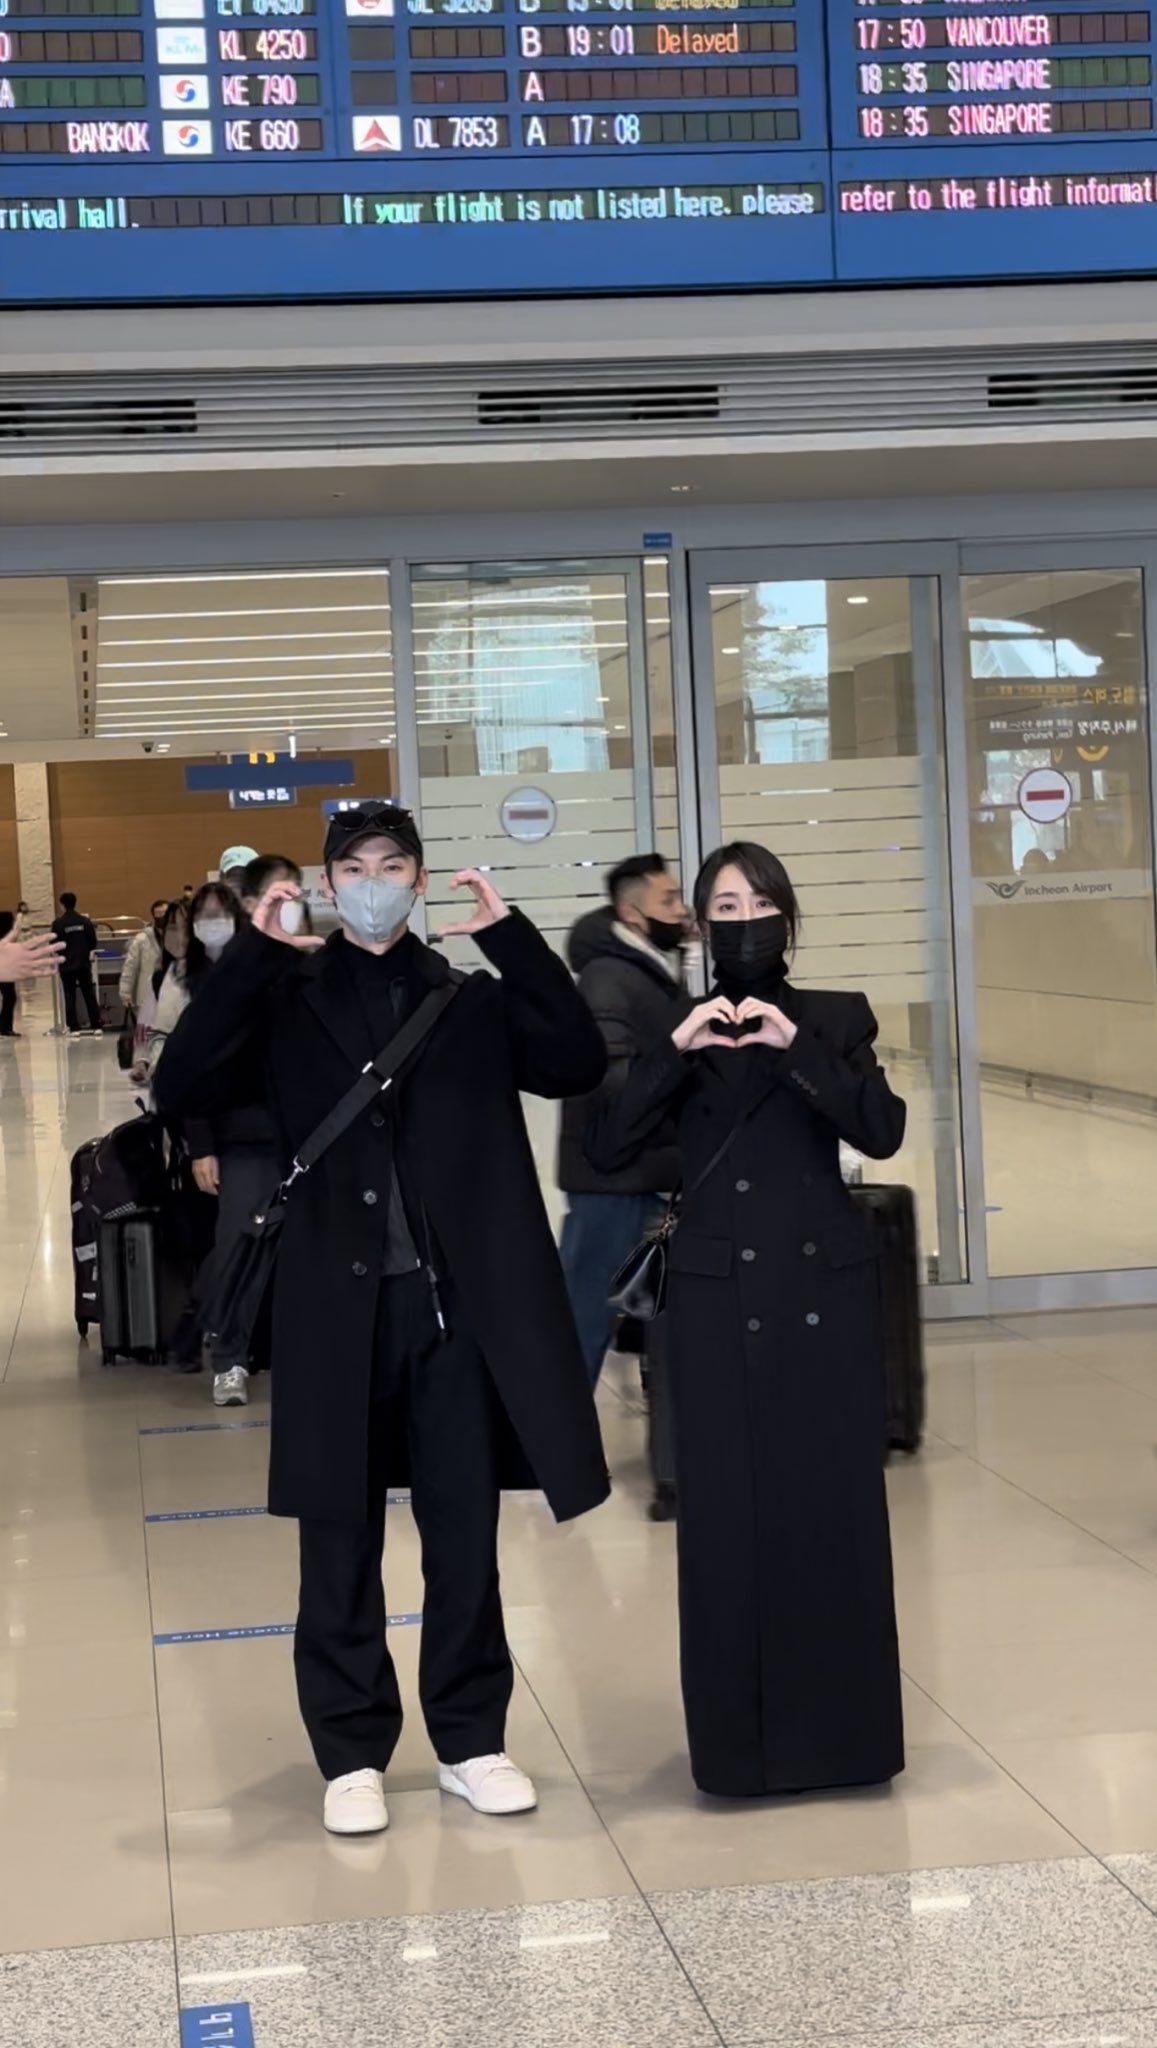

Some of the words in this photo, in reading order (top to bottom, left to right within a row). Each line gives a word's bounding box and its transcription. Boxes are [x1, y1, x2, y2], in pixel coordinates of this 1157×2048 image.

[219, 30, 247, 61] KL
[256, 30, 306, 60] 4250
[521, 26, 542, 57] B
[567, 26, 634, 55] 19:01
[657, 24, 739, 54] Delayed
[858, 18, 926, 49] 17:50
[946, 15, 1050, 47] VANCOUVER
[222, 75, 249, 106] KE
[257, 75, 297, 105] 790
[524, 72, 544, 101] A
[860, 62, 928, 93] 18:35
[947, 59, 1051, 91] SINGAPORE
[225, 121, 252, 151] KE
[260, 120, 298, 150] 660
[413, 118, 439, 148] DL
[449, 117, 497, 147] 7853
[527, 116, 546, 146] A
[571, 114, 640, 144] 17:08
[861, 107, 928, 137] 18:35
[949, 103, 1052, 135] SINGAPORE
[78, 198, 139, 228] hall.
[344, 194, 364, 224] If
[375, 202, 423, 224] your
[434, 192, 504, 223] flight
[517, 193, 541, 220] is
[550, 193, 584, 220] not
[597, 189, 666, 219] listed
[742, 185, 814, 215] please
[841, 185, 896, 212] refer
[908, 184, 931, 210] to
[941, 180, 977, 210] the
[987, 177, 1052, 208] flight
[1024, 885, 1069, 896] Incheon
[1073, 883, 1113, 894] Airport
